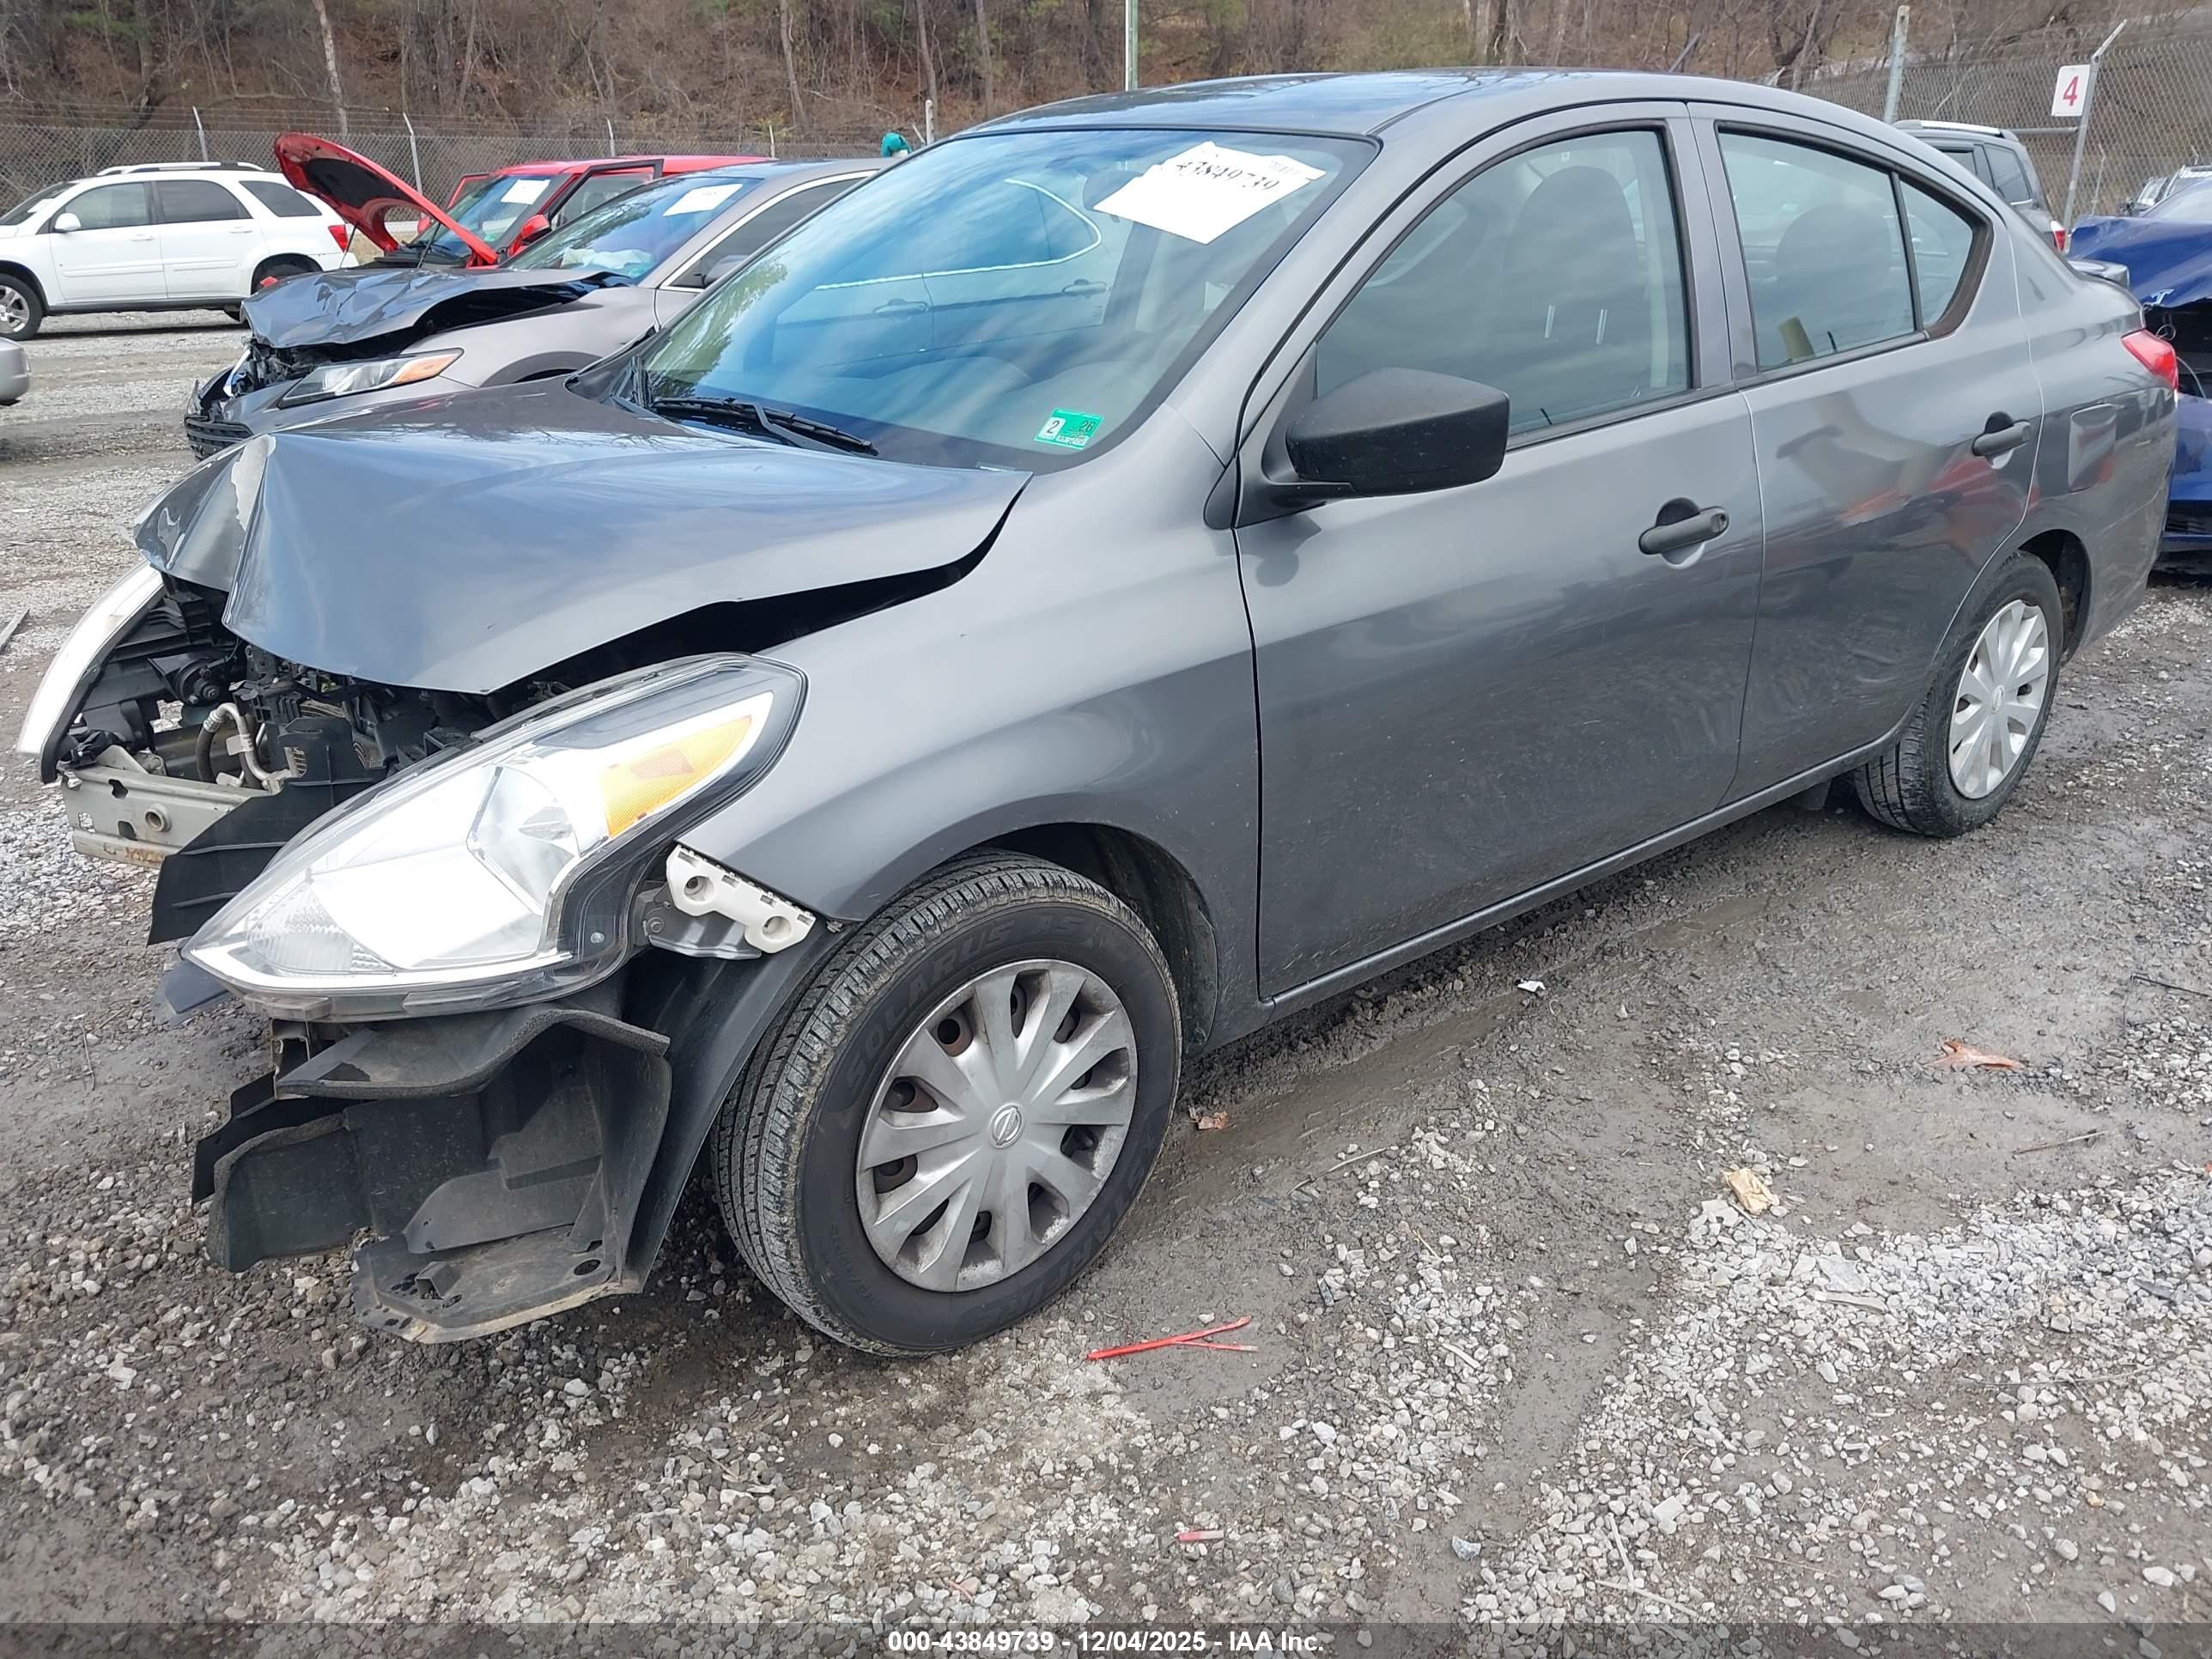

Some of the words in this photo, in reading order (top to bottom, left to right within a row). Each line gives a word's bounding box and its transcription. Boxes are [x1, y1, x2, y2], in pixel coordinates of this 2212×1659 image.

[2063, 76, 2079, 106] 4
[1046, 420, 1060, 434] 2
[842, 919, 1013, 1091] SOLARUS
